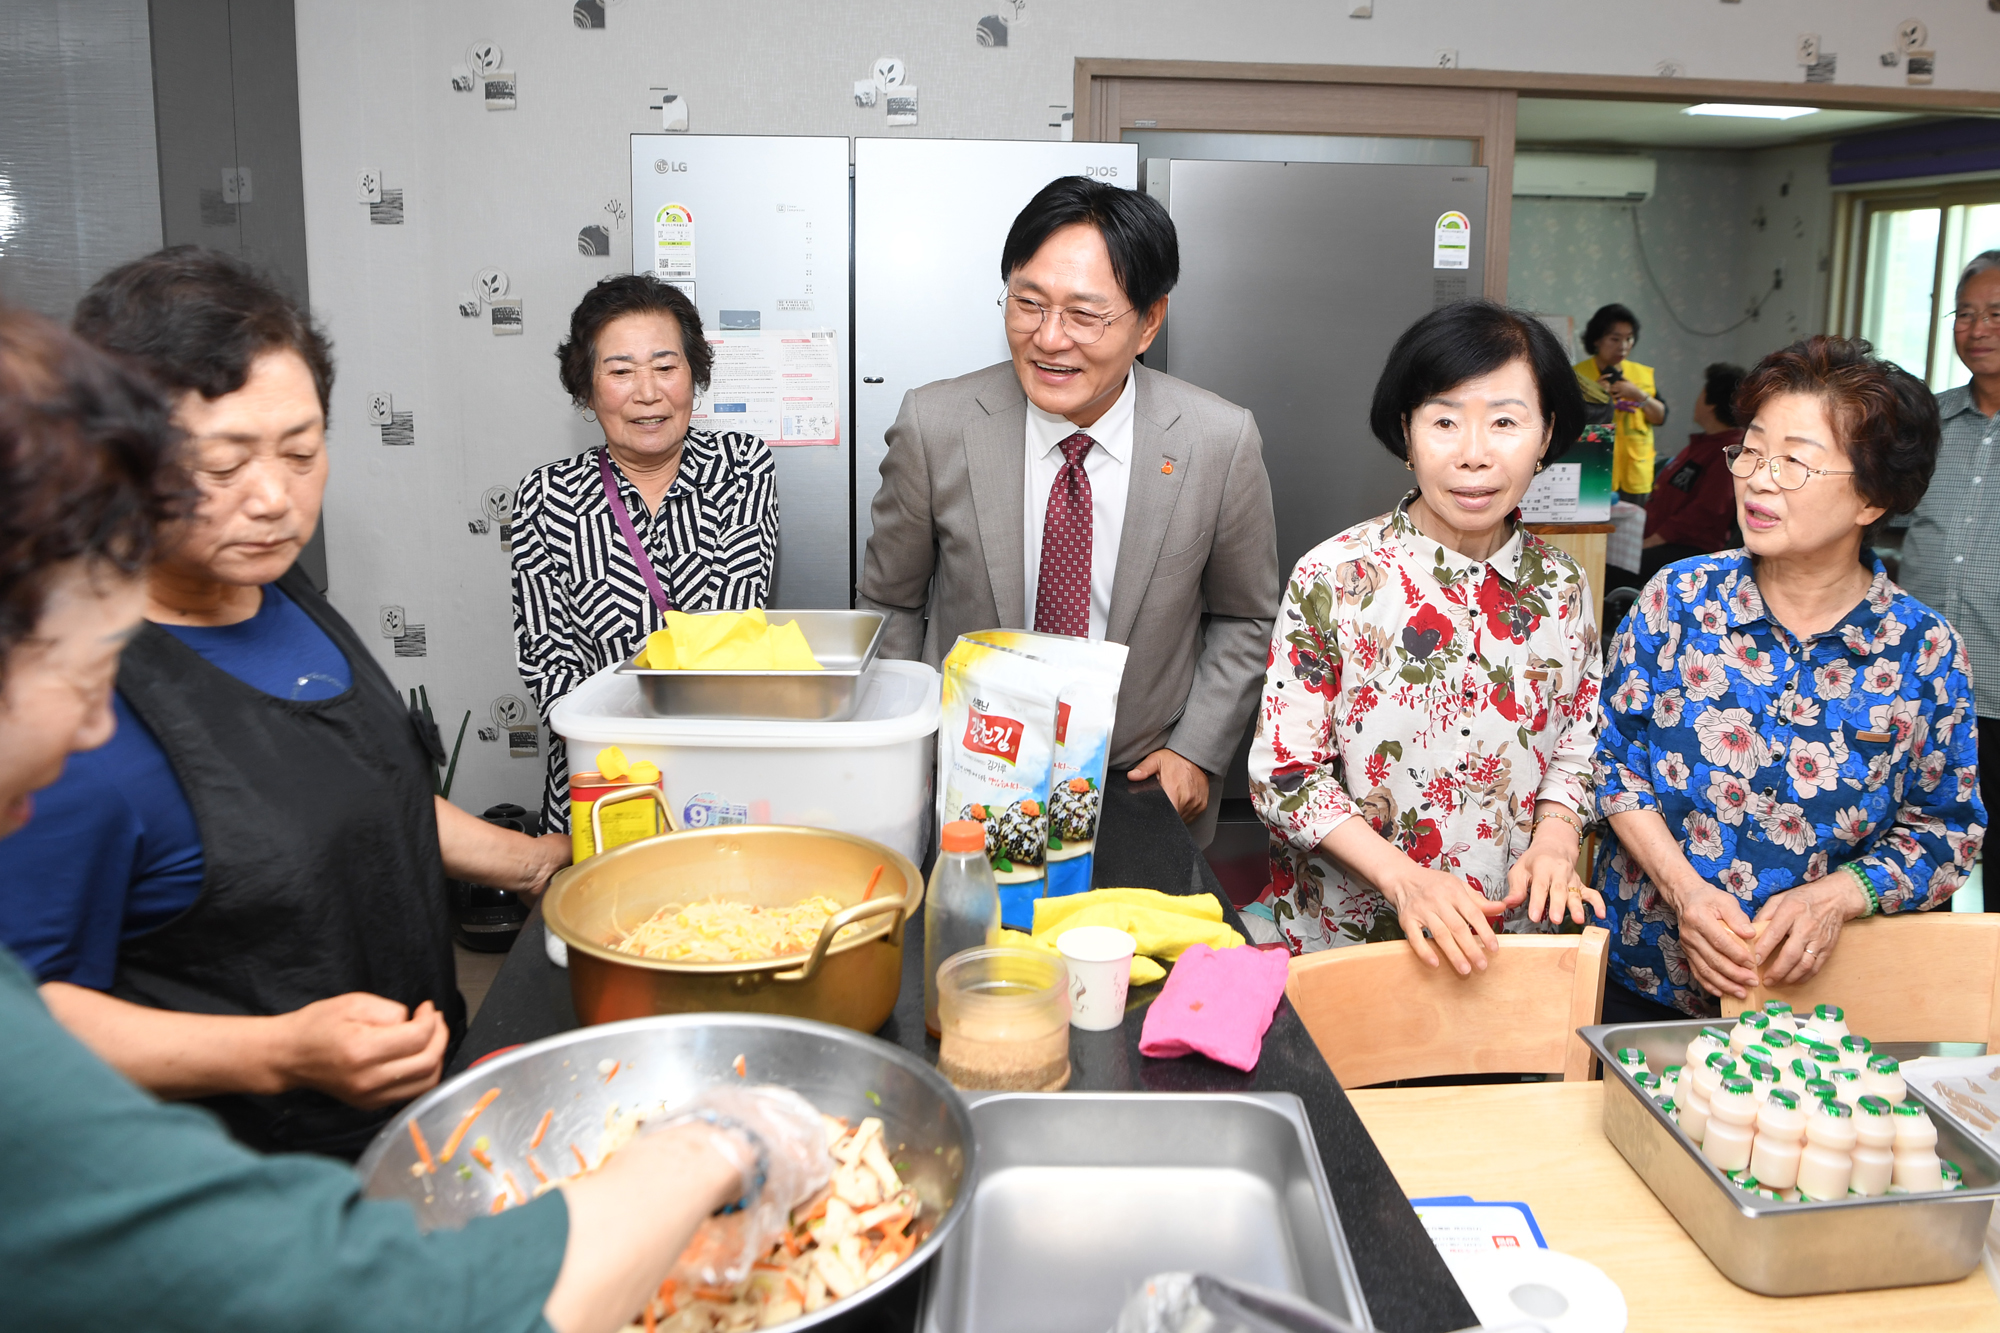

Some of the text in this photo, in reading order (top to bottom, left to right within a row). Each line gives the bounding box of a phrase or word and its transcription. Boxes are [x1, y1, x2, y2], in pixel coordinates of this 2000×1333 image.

[671, 161, 687, 172] LG
[1085, 165, 1118, 177] DIOS
[970, 717, 1013, 752] 광천김
[987, 759, 1007, 774] 김가루
[690, 805, 707, 827] 9
